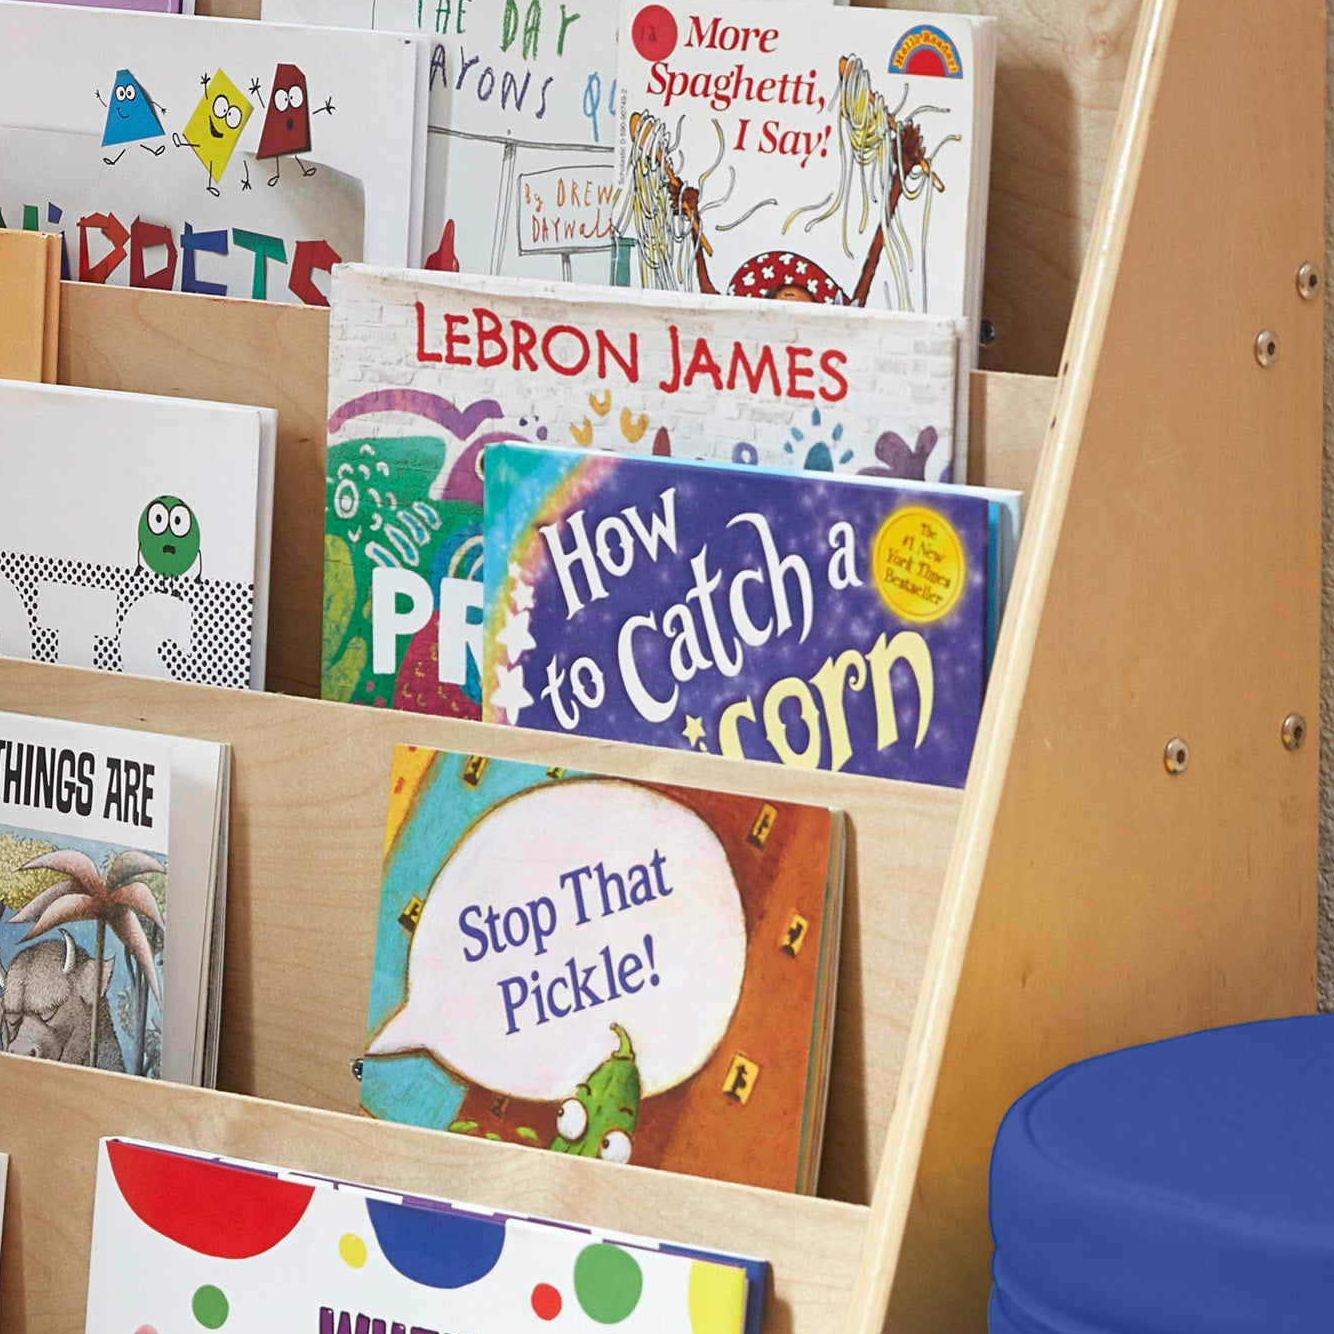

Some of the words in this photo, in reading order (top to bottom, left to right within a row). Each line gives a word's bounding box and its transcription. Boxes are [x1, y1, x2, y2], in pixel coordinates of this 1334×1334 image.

[684, 15, 779, 53] More
[646, 61, 826, 111] Spaghetti,
[733, 119, 751, 151] I
[758, 120, 832, 169] Say!
[557, 178, 613, 207] DREW
[415, 302, 638, 384] LEBRON
[659, 327, 848, 402] JAMES
[540, 487, 679, 620] How
[884, 567, 943, 605] Bestseller
[541, 655, 605, 730] to
[617, 512, 813, 723] Catch
[827, 521, 863, 590] a
[700, 631, 934, 771] corn
[104, 757, 156, 829] ARE
[458, 895, 557, 962] Stop
[560, 848, 674, 926] That
[497, 933, 661, 1035] Pickle!
